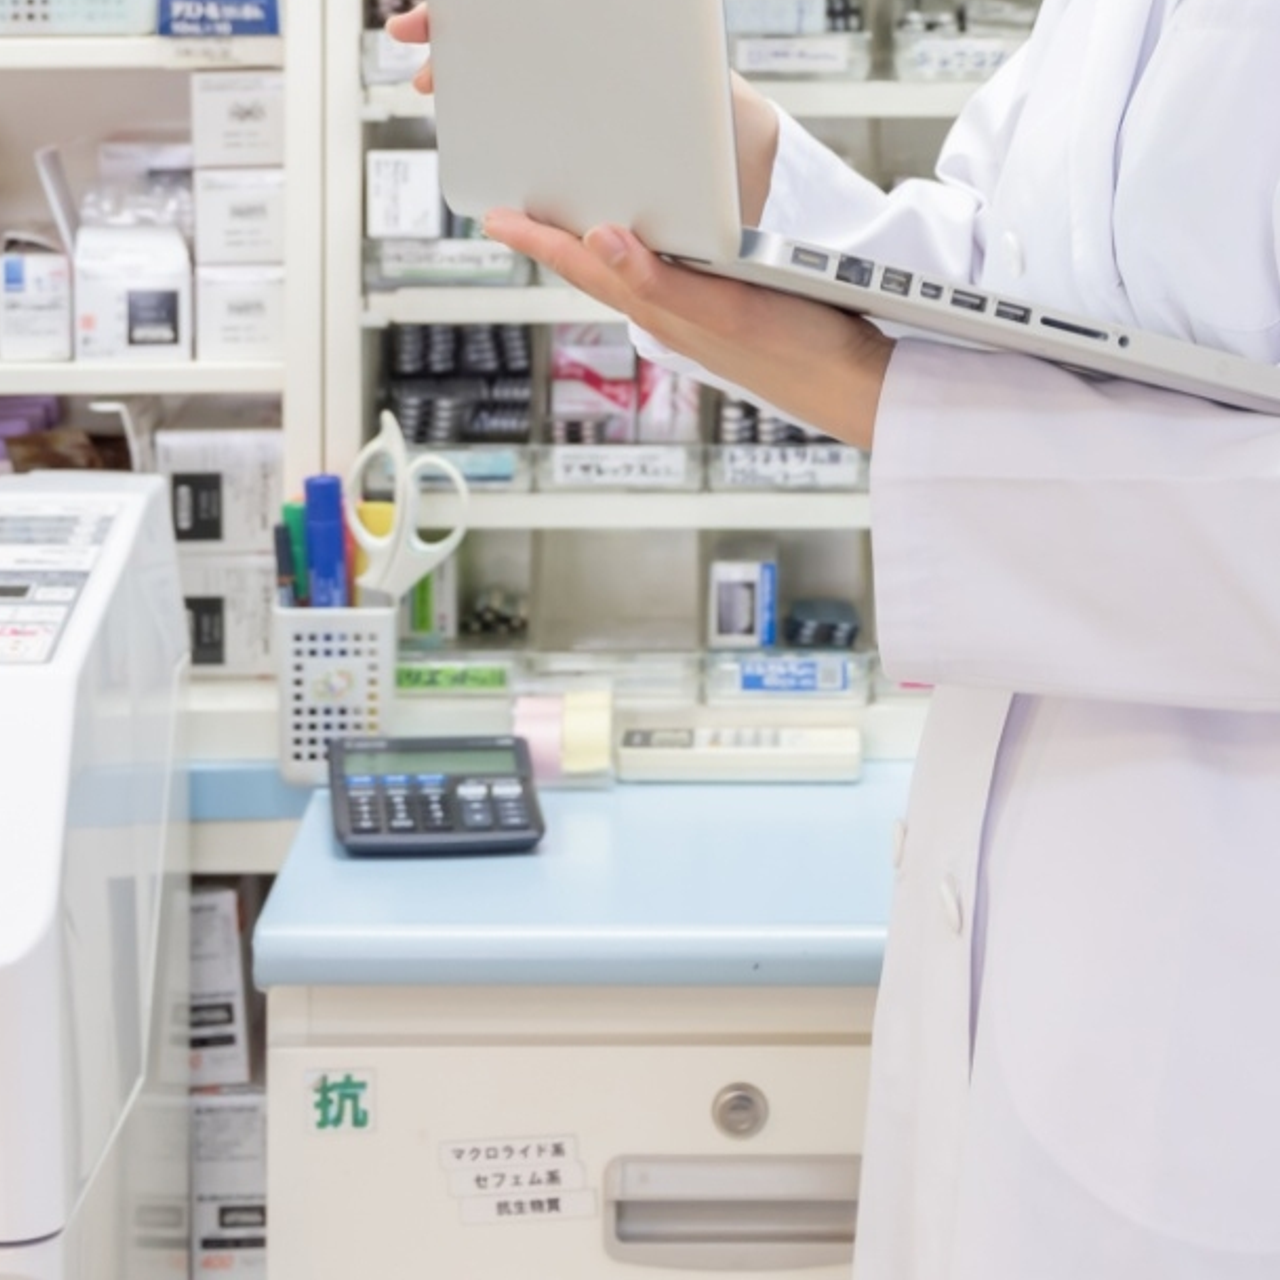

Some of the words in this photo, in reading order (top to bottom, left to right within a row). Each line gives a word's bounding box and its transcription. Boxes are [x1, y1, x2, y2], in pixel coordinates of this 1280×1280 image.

[313, 1074, 368, 1129] 抗
[451, 1142, 566, 1161] マクロライド系
[473, 1170, 562, 1189] セフェム系
[495, 1197, 561, 1215] 抗生物質
